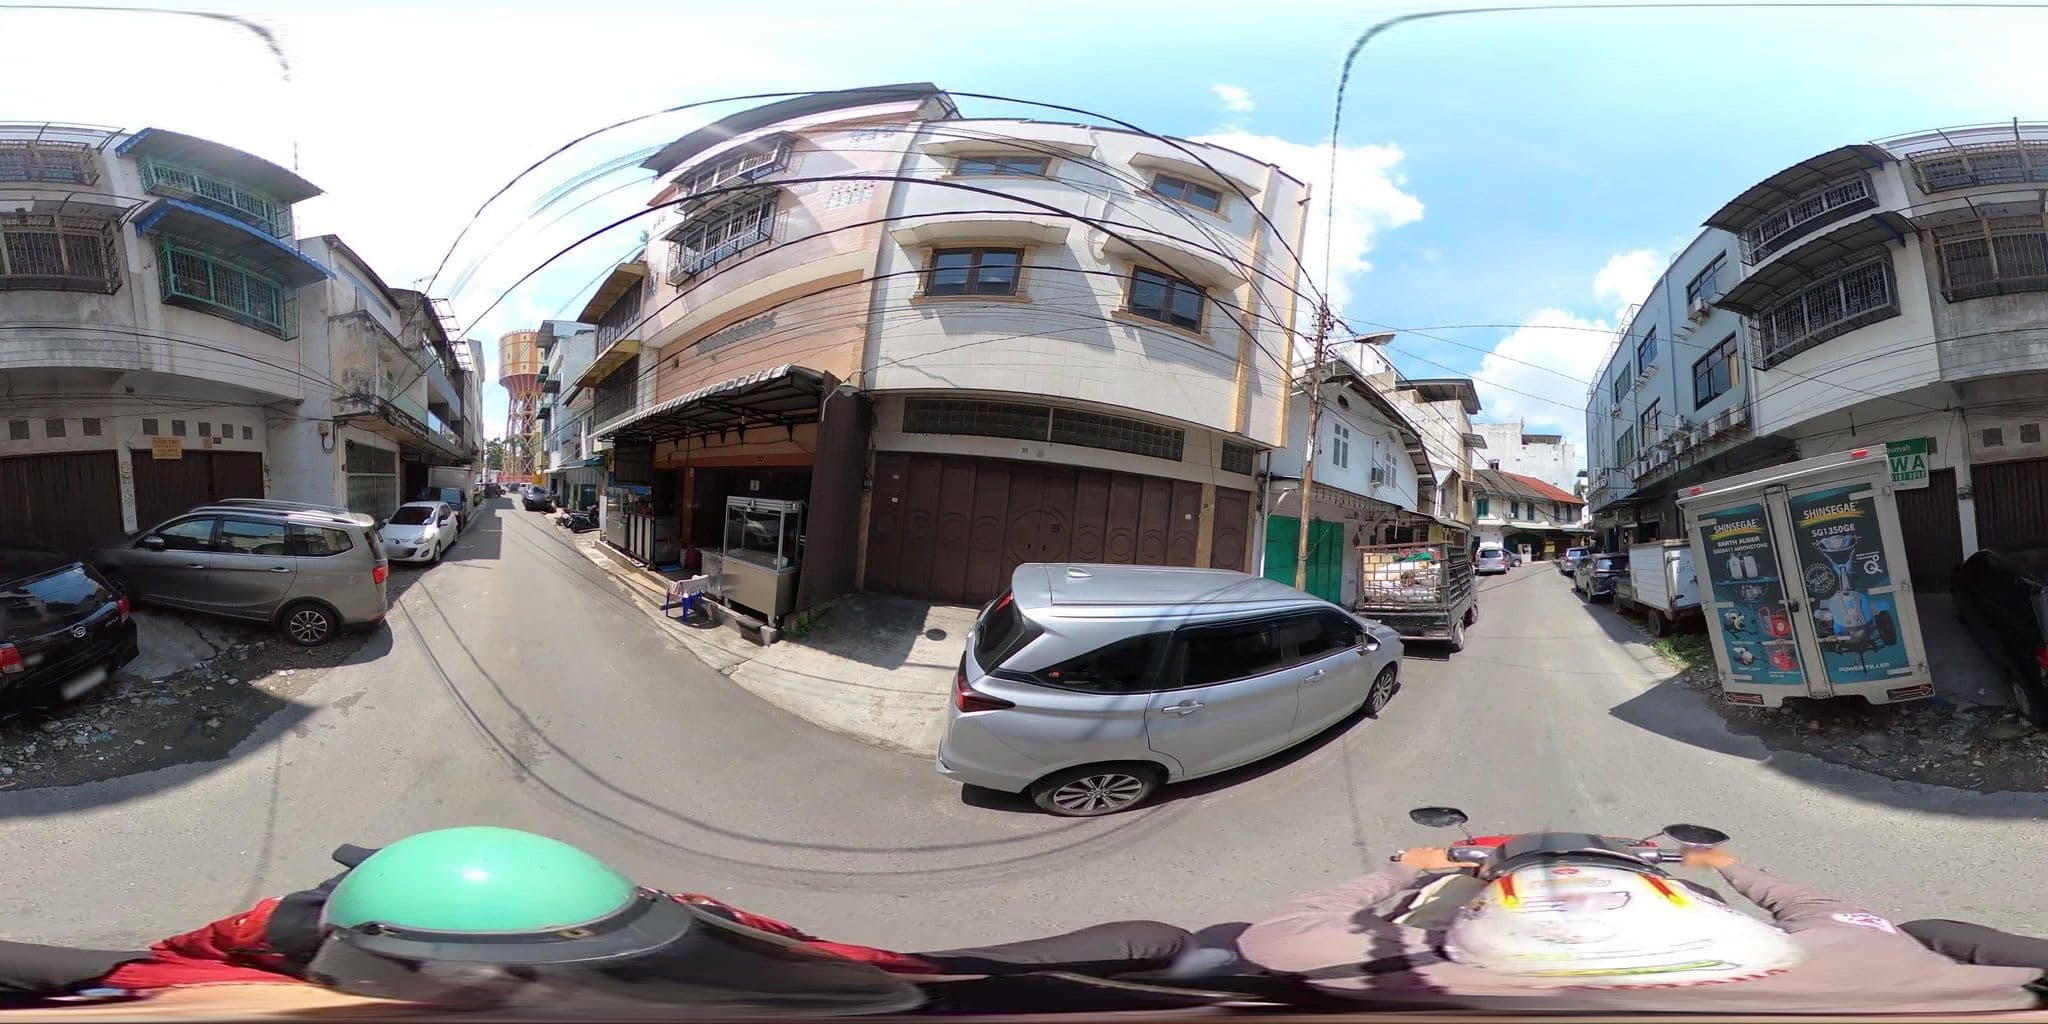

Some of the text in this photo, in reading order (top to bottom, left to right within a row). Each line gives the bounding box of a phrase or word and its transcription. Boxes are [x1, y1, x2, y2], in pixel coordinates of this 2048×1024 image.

[1803, 502, 1857, 519] SHINSEGAE
[1713, 519, 1757, 533] SHINSEGAE
[1811, 523, 1856, 537] SG1350GE
[1717, 536, 1761, 548] EARTH AUGER
